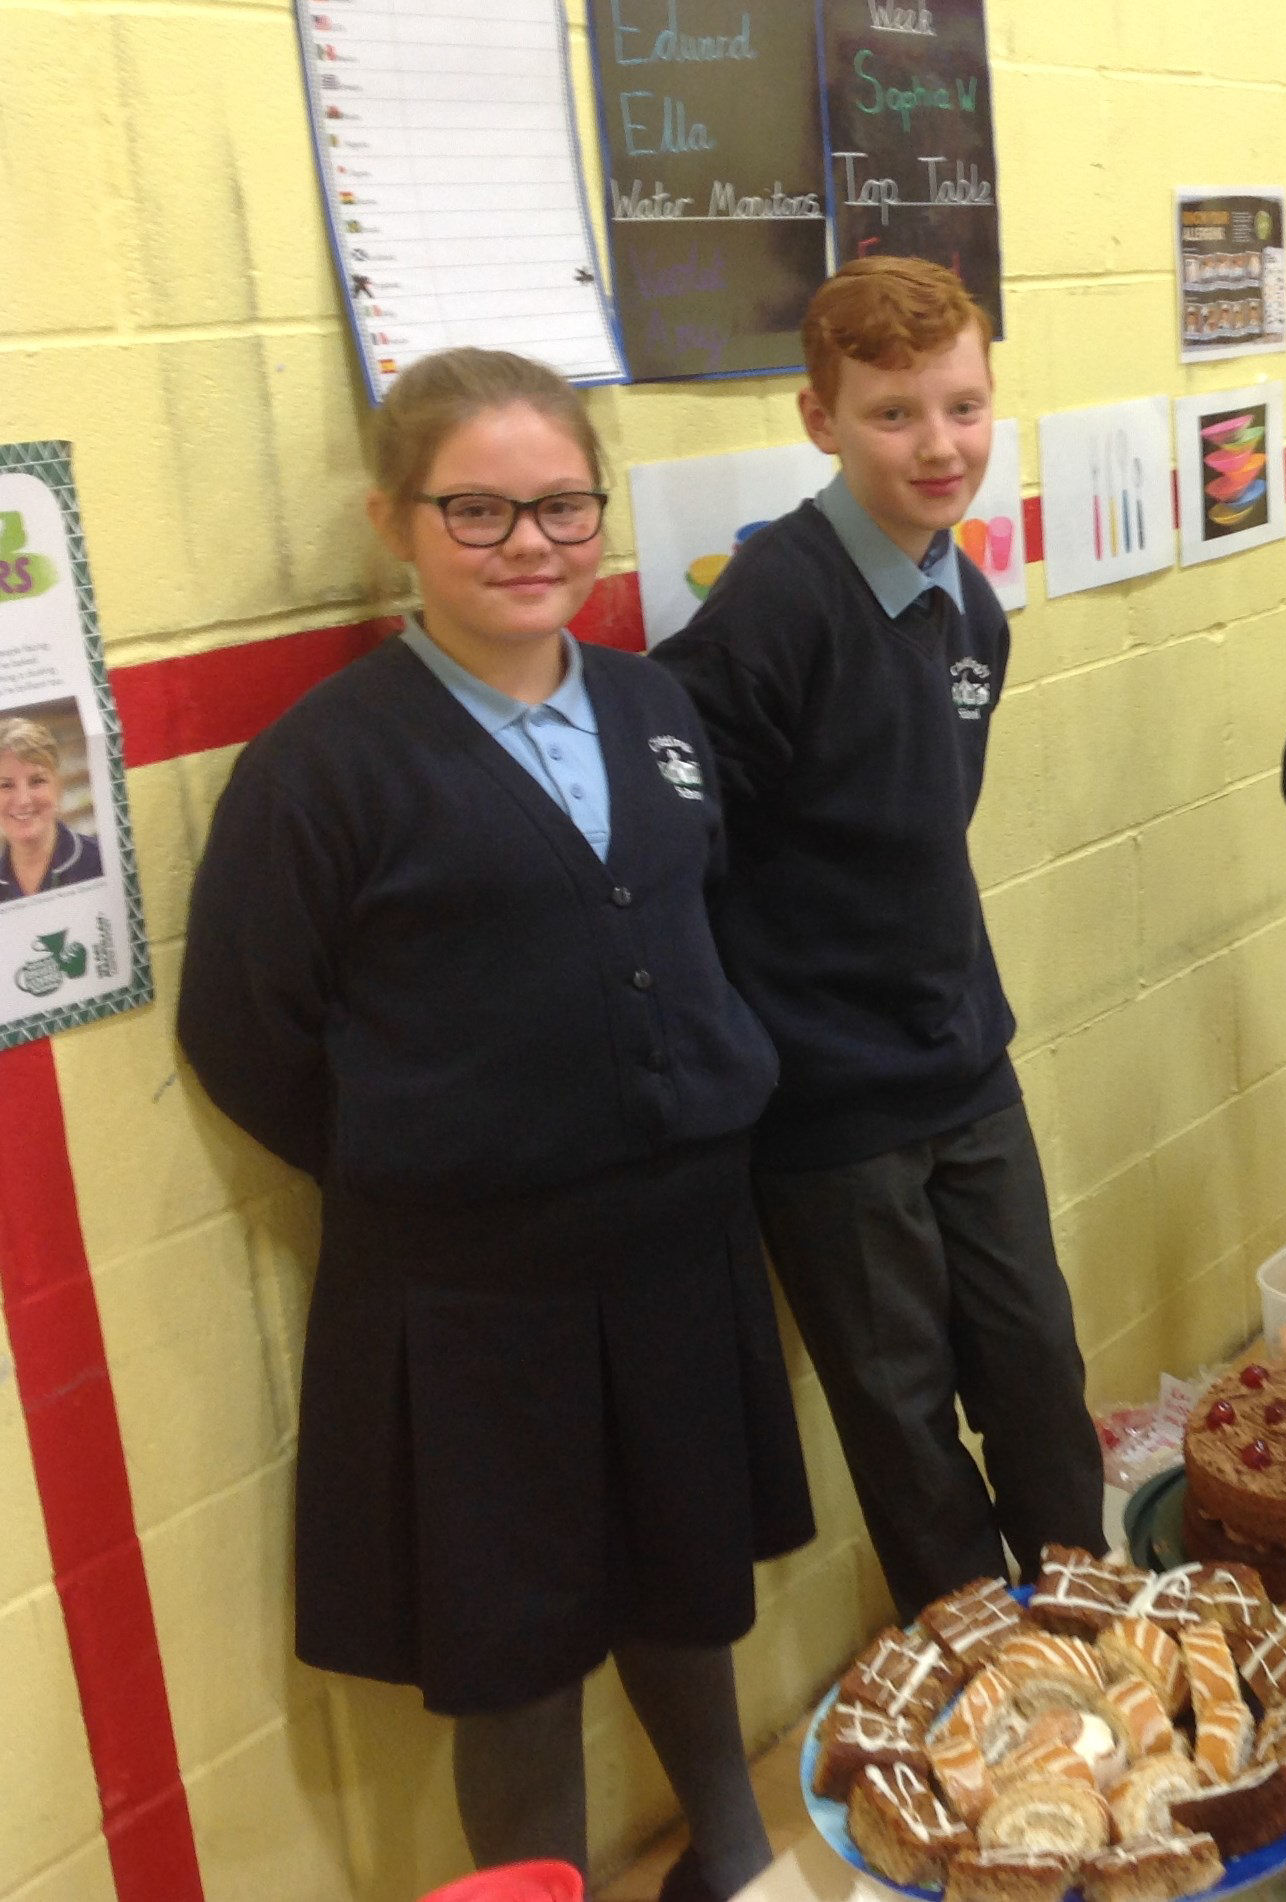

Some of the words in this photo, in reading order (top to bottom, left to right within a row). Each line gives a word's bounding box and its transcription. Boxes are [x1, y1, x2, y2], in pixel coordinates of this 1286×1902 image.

[620, 90, 716, 156] Ella
[611, 178, 694, 217] Water
[709, 179, 822, 217] Monitors
[832, 152, 899, 226] Top
[917, 156, 992, 203] Table
